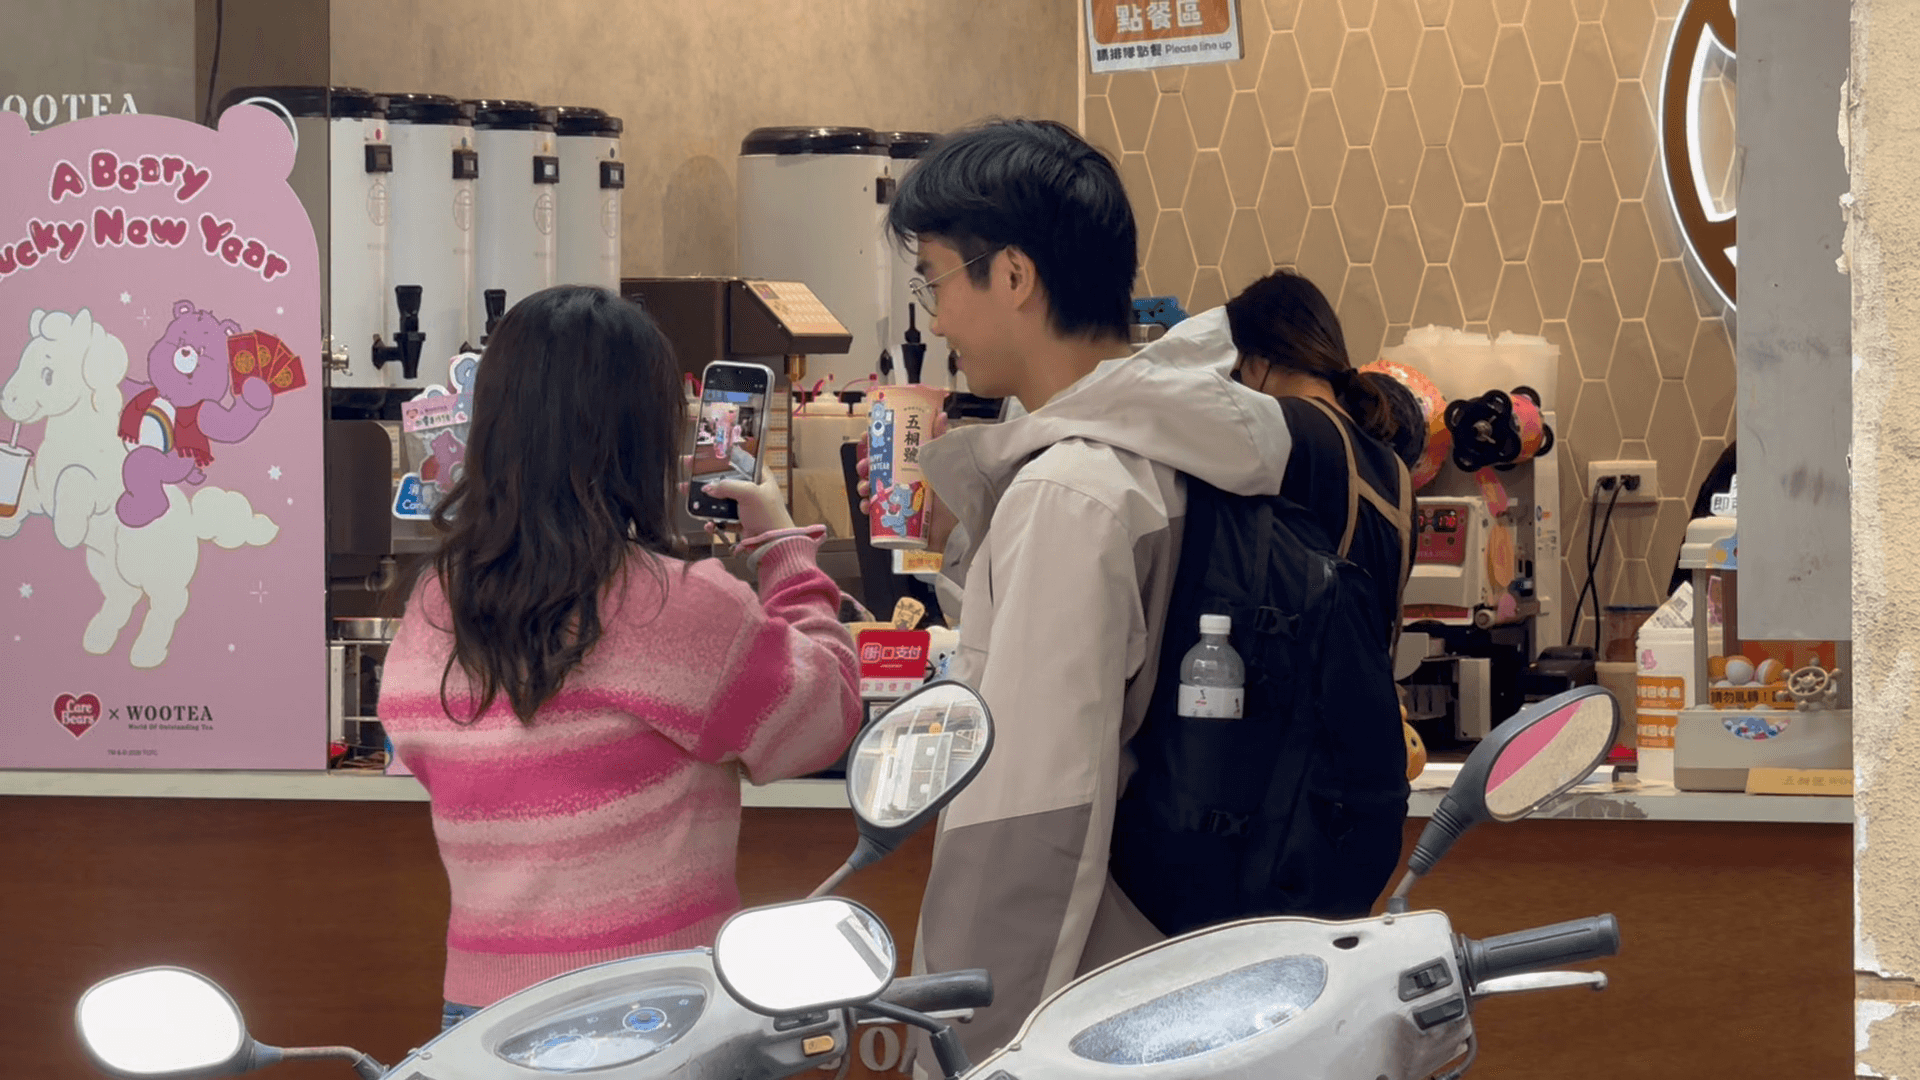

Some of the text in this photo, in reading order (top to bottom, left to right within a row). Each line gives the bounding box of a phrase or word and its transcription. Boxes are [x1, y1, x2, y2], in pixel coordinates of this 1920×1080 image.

[1115, 0, 1204, 34] 點餐區
[1096, 41, 1232, 62] 請排隊點餐 Please line up
[50, 149, 212, 203] A Beary
[92, 206, 189, 248] New
[199, 213, 290, 281] Year
[65, 698, 93, 714] Care
[126, 705, 214, 721] WOOTEA
[61, 711, 95, 726] Bears
